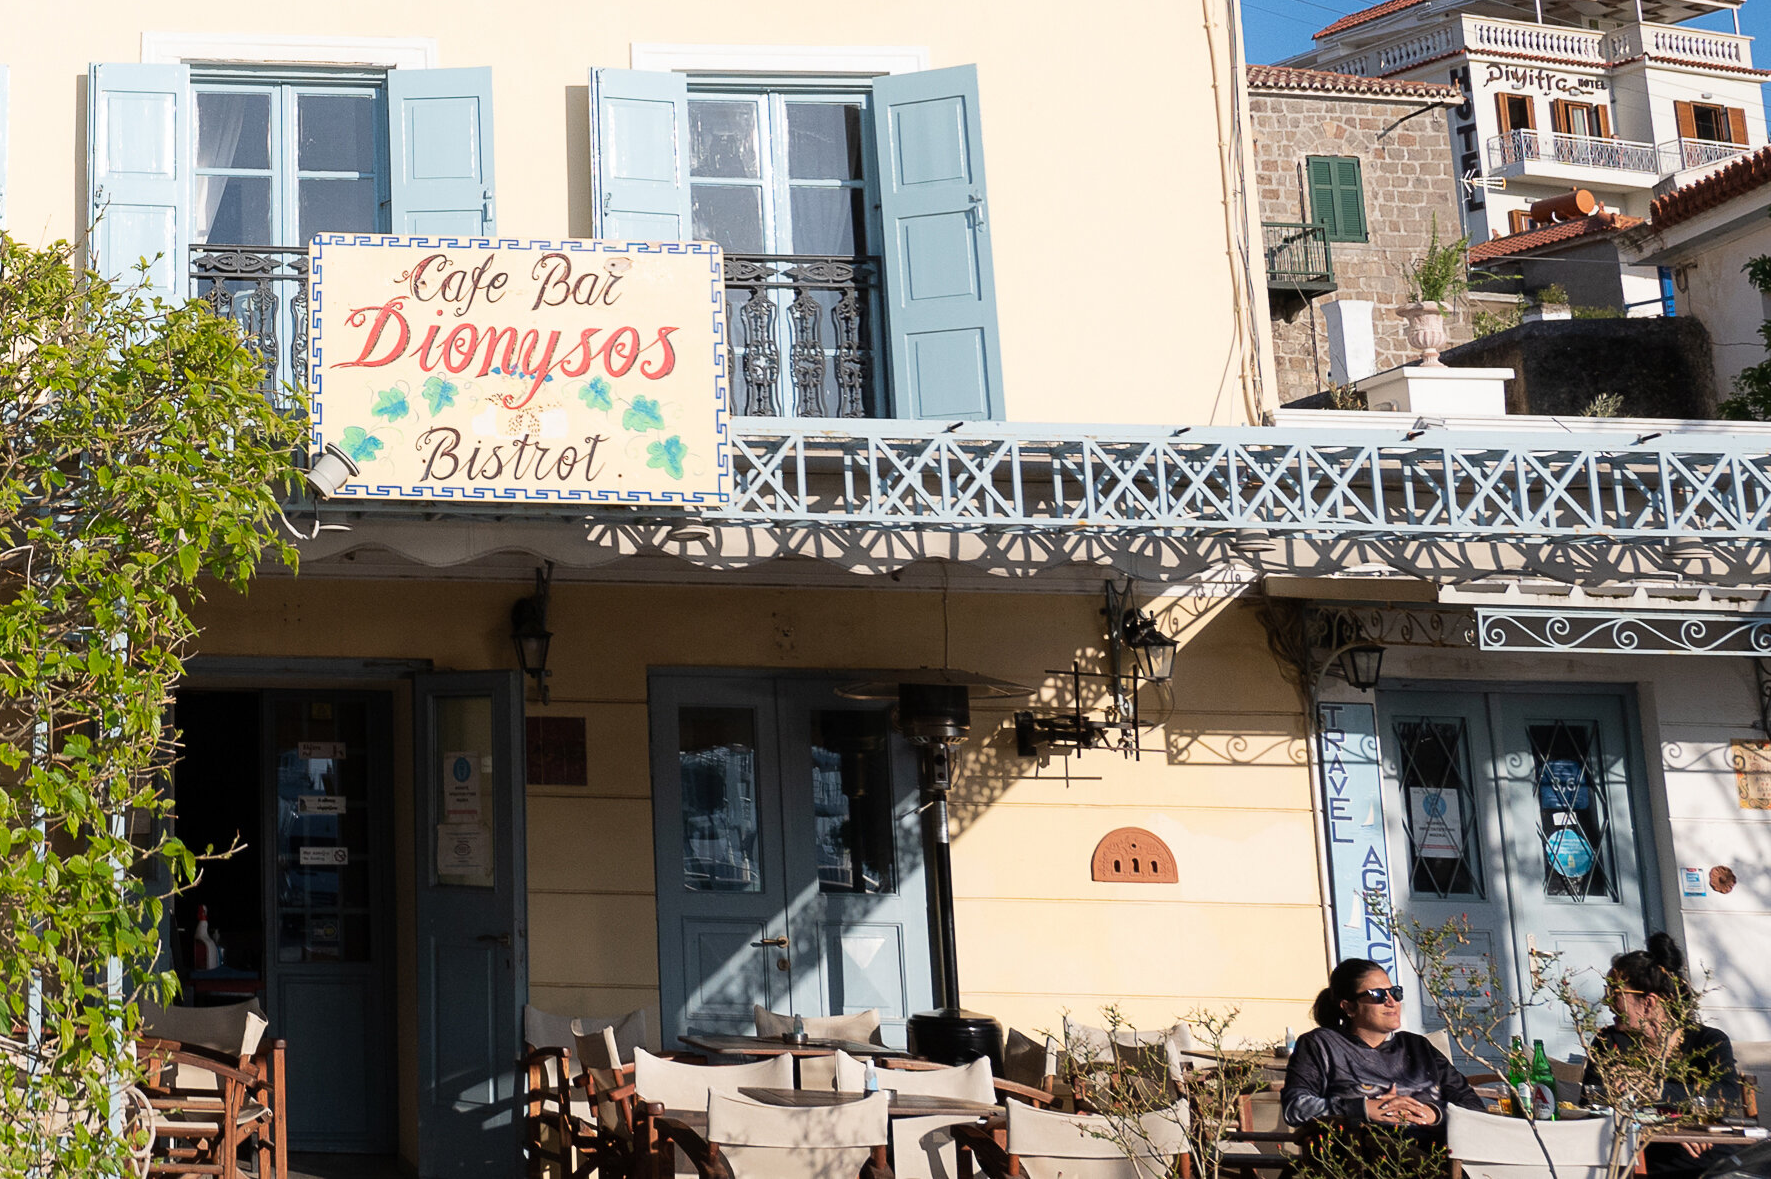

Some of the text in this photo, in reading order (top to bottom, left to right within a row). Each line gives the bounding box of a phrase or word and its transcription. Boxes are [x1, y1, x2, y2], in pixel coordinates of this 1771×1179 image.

[1577, 77, 1607, 90] HOTEL
[393, 252, 624, 317] Cafe Bar
[330, 296, 680, 410] Dionysos
[415, 425, 611, 482] Bistrot
[1321, 705, 1354, 843] TRAVEL
[1361, 845, 1394, 976] AGENC
